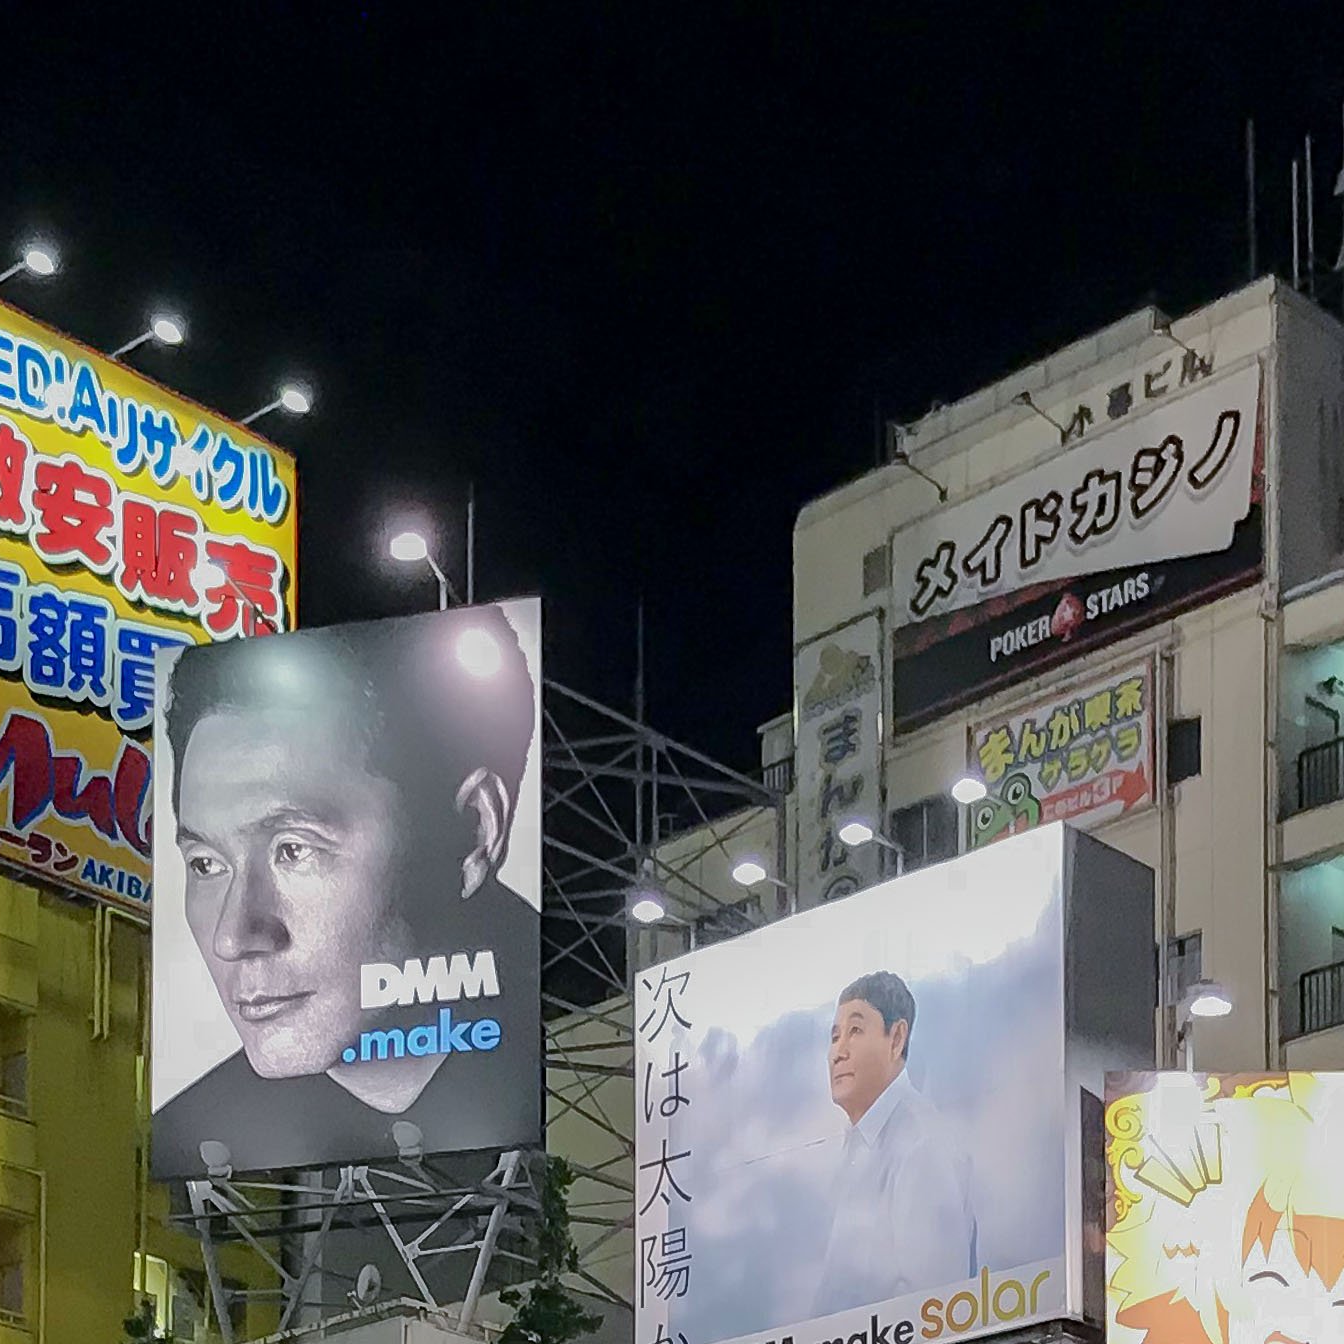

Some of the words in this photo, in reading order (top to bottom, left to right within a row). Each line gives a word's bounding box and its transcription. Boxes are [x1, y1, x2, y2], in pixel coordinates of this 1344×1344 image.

[910, 410, 1241, 617] メイドカジノ
[989, 616, 1052, 663] POKER
[1086, 572, 1150, 621] STARS
[360, 951, 500, 1010] DMM
[342, 1009, 501, 1064] .make
[920, 1266, 1052, 1342] solar
